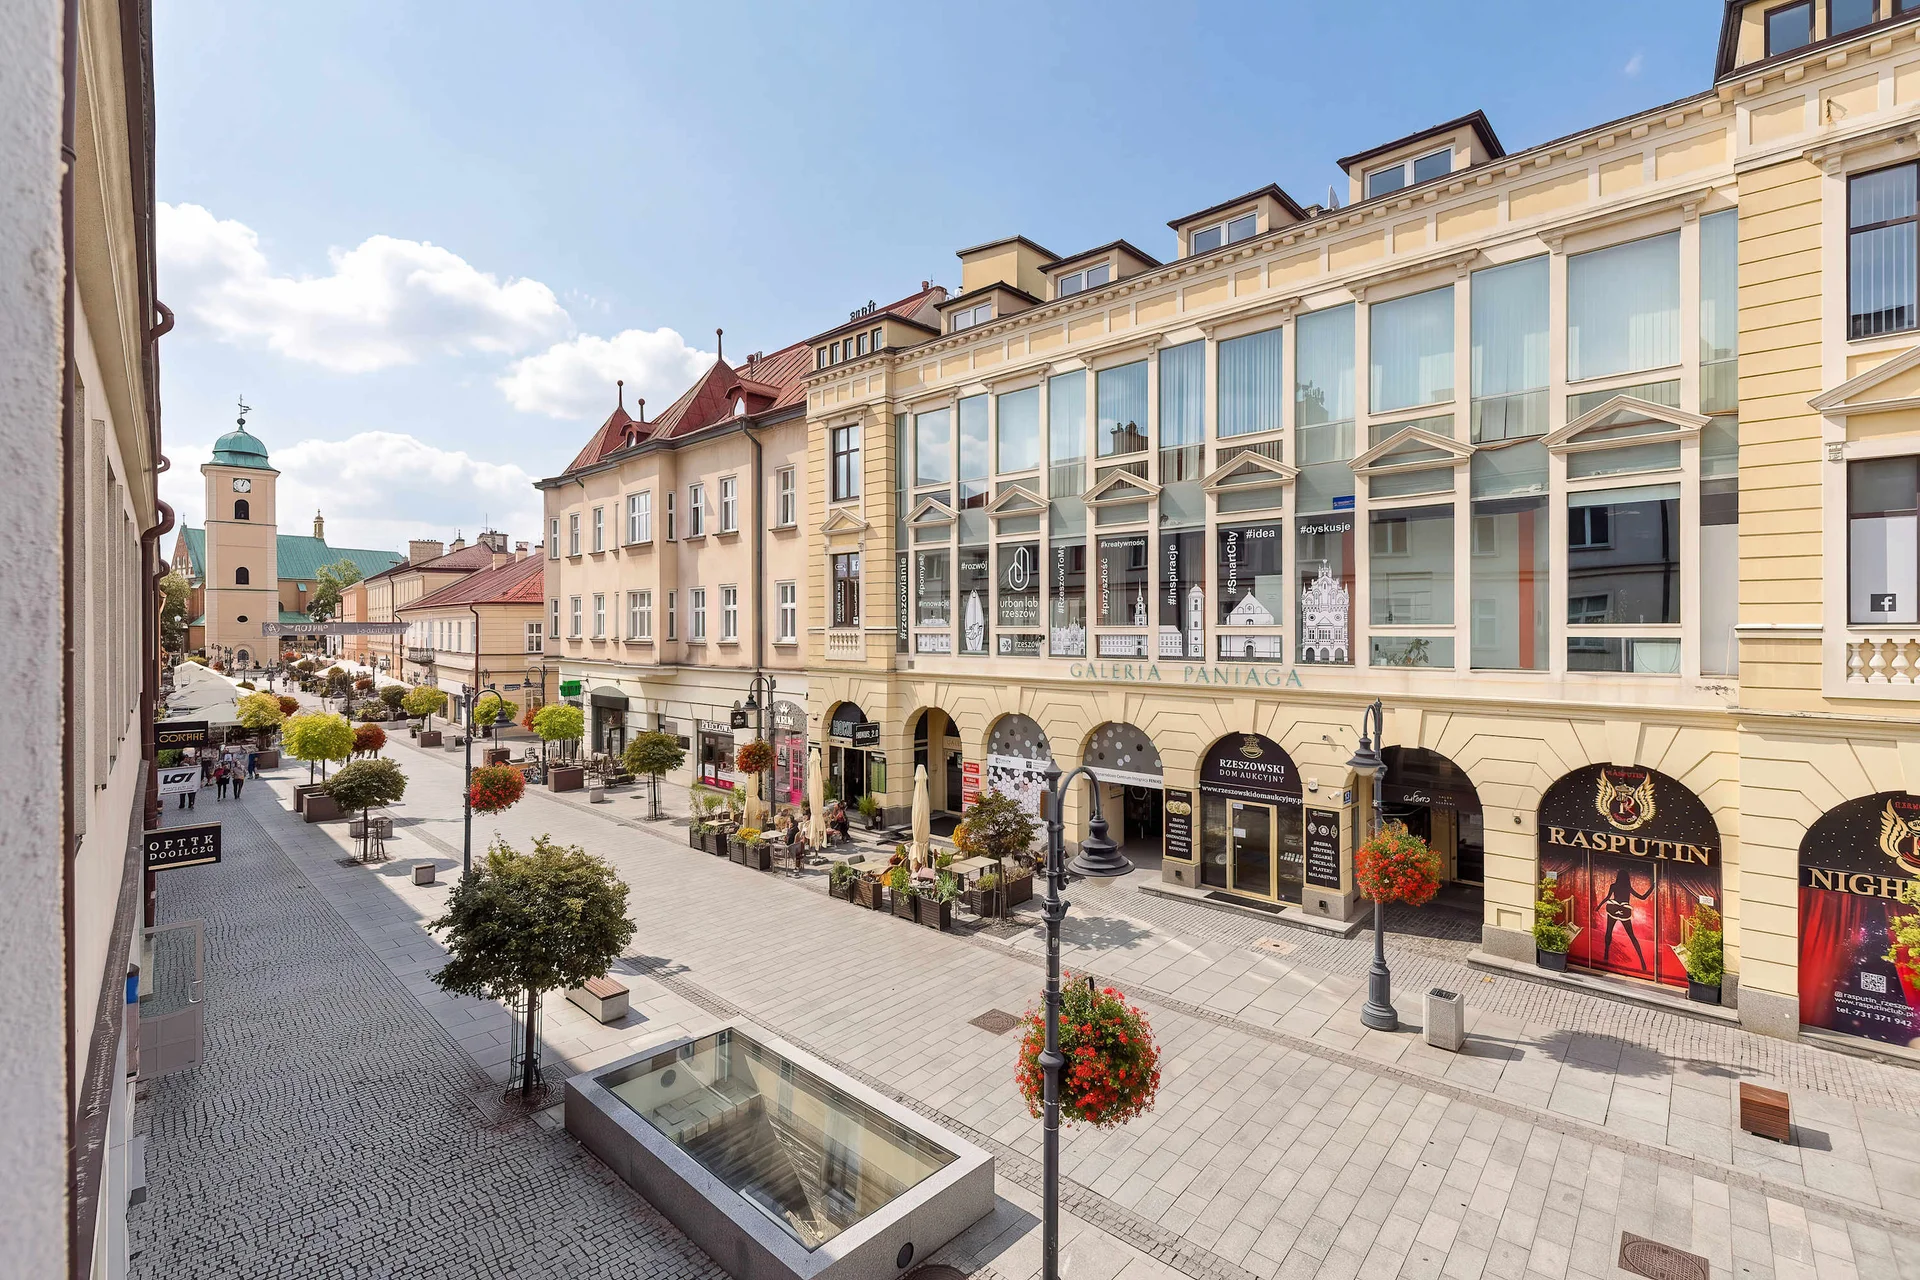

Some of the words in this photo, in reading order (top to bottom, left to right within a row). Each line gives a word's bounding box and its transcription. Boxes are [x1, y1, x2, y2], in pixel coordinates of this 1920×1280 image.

[1246, 528, 1275, 539] #idea
[1300, 522, 1351, 535] #dyskusje
[1101, 539, 1145, 548] #kreatywność
[961, 560, 988, 571] #rozwój
[1227, 531, 1239, 595] #SmartCity
[1168, 544, 1178, 606] #inspiracje
[899, 557, 907, 640] #rzeszowianie
[1000, 595, 1024, 608] urban
[1025, 595, 1039, 608] lab
[1002, 607, 1036, 618] rzeszów
[1070, 662, 1162, 681] GALERIA
[1184, 665, 1303, 687] PANIAGA
[1219, 758, 1285, 774] RZESZOWSKI
[1219, 769, 1238, 778] DOM
[1239, 772, 1285, 783] AUKCYJNY
[1547, 826, 1712, 866] RASPUTIN
[1843, 992, 1915, 1011] rasputin_rzeszow
[1874, 1014, 1892, 1023] 371
[1893, 1018, 1913, 1028] 942
